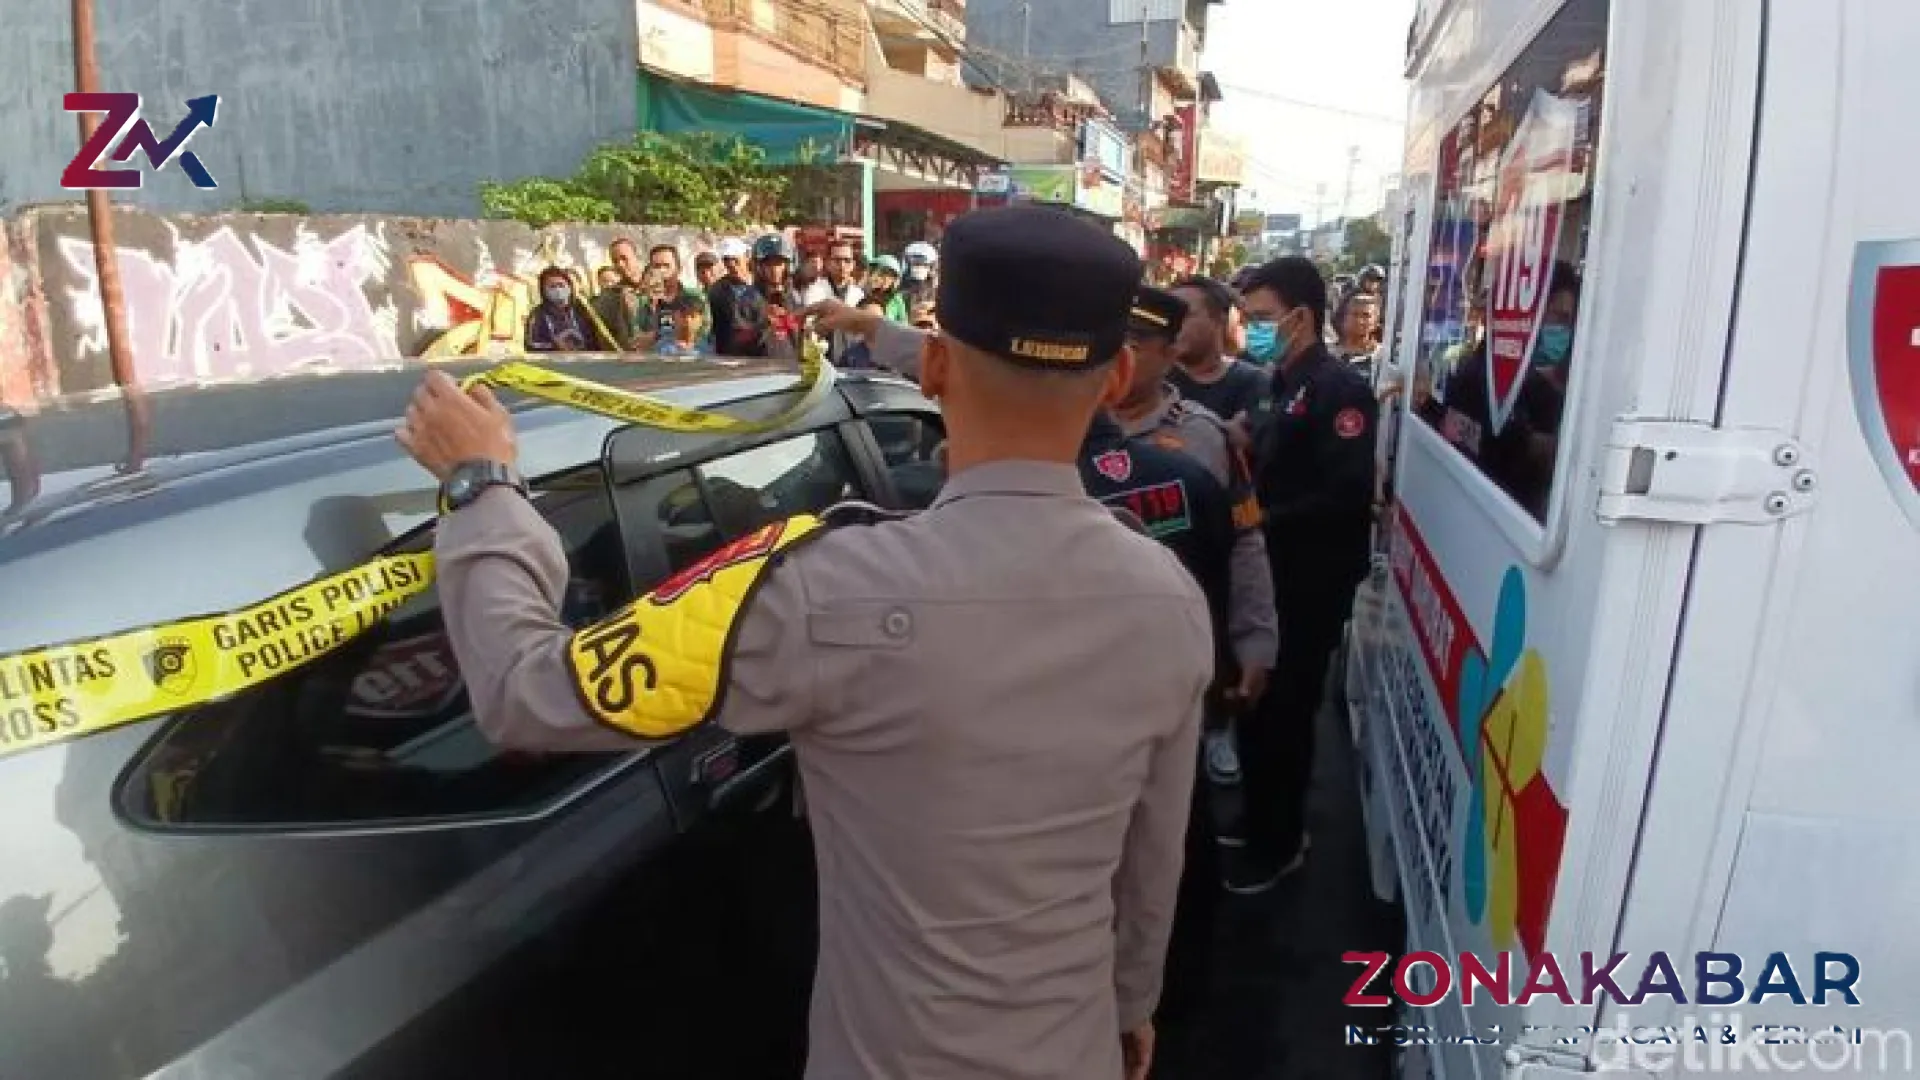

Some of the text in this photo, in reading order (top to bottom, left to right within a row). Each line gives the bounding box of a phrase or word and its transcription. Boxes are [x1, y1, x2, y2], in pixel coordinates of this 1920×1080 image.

[213, 560, 421, 650] GARIS POLISI
[236, 619, 346, 668] POLICE
[0, 648, 116, 699] LINTAS
